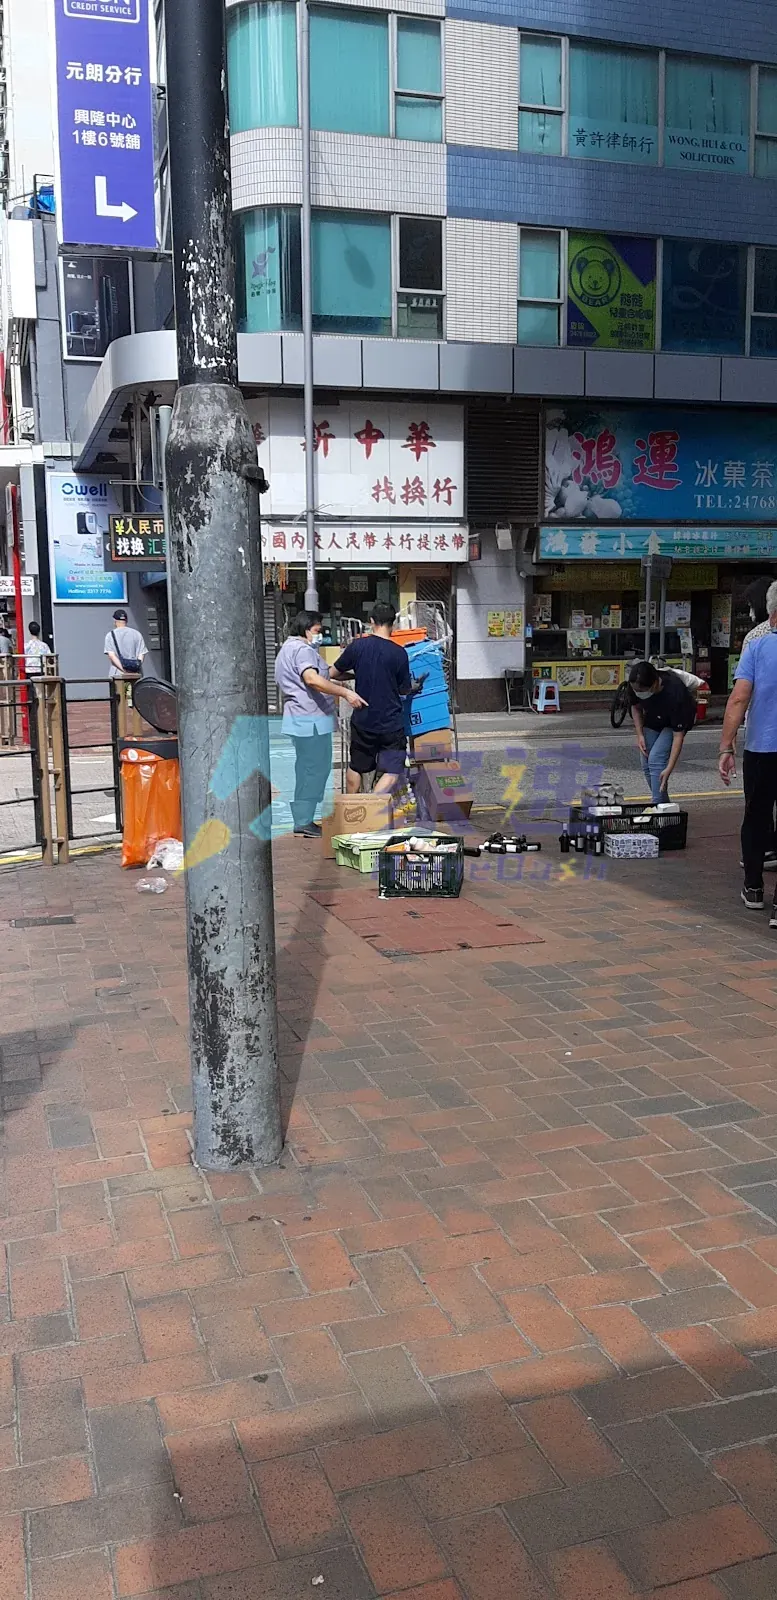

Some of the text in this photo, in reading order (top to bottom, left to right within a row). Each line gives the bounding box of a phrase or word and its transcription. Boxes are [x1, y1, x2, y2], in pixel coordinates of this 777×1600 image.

[71, 1, 132, 16] CREDIT SERVICE
[66, 61, 143, 86] 元朗分行
[73, 108, 137, 129] 興隆中心
[72, 130, 141, 150] 1樓6號舖
[572, 128, 654, 154] 黃許律師行
[702, 140, 718, 149] HUI
[719, 141, 727, 150] &
[680, 151, 735, 165] SOLICITORS
[581, 294, 610, 306] BEAR
[572, 428, 683, 490] 鴻運
[694, 458, 775, 489] 冰菓茶
[371, 475, 458, 506] 找換行
[116, 537, 145, 556] 找换
